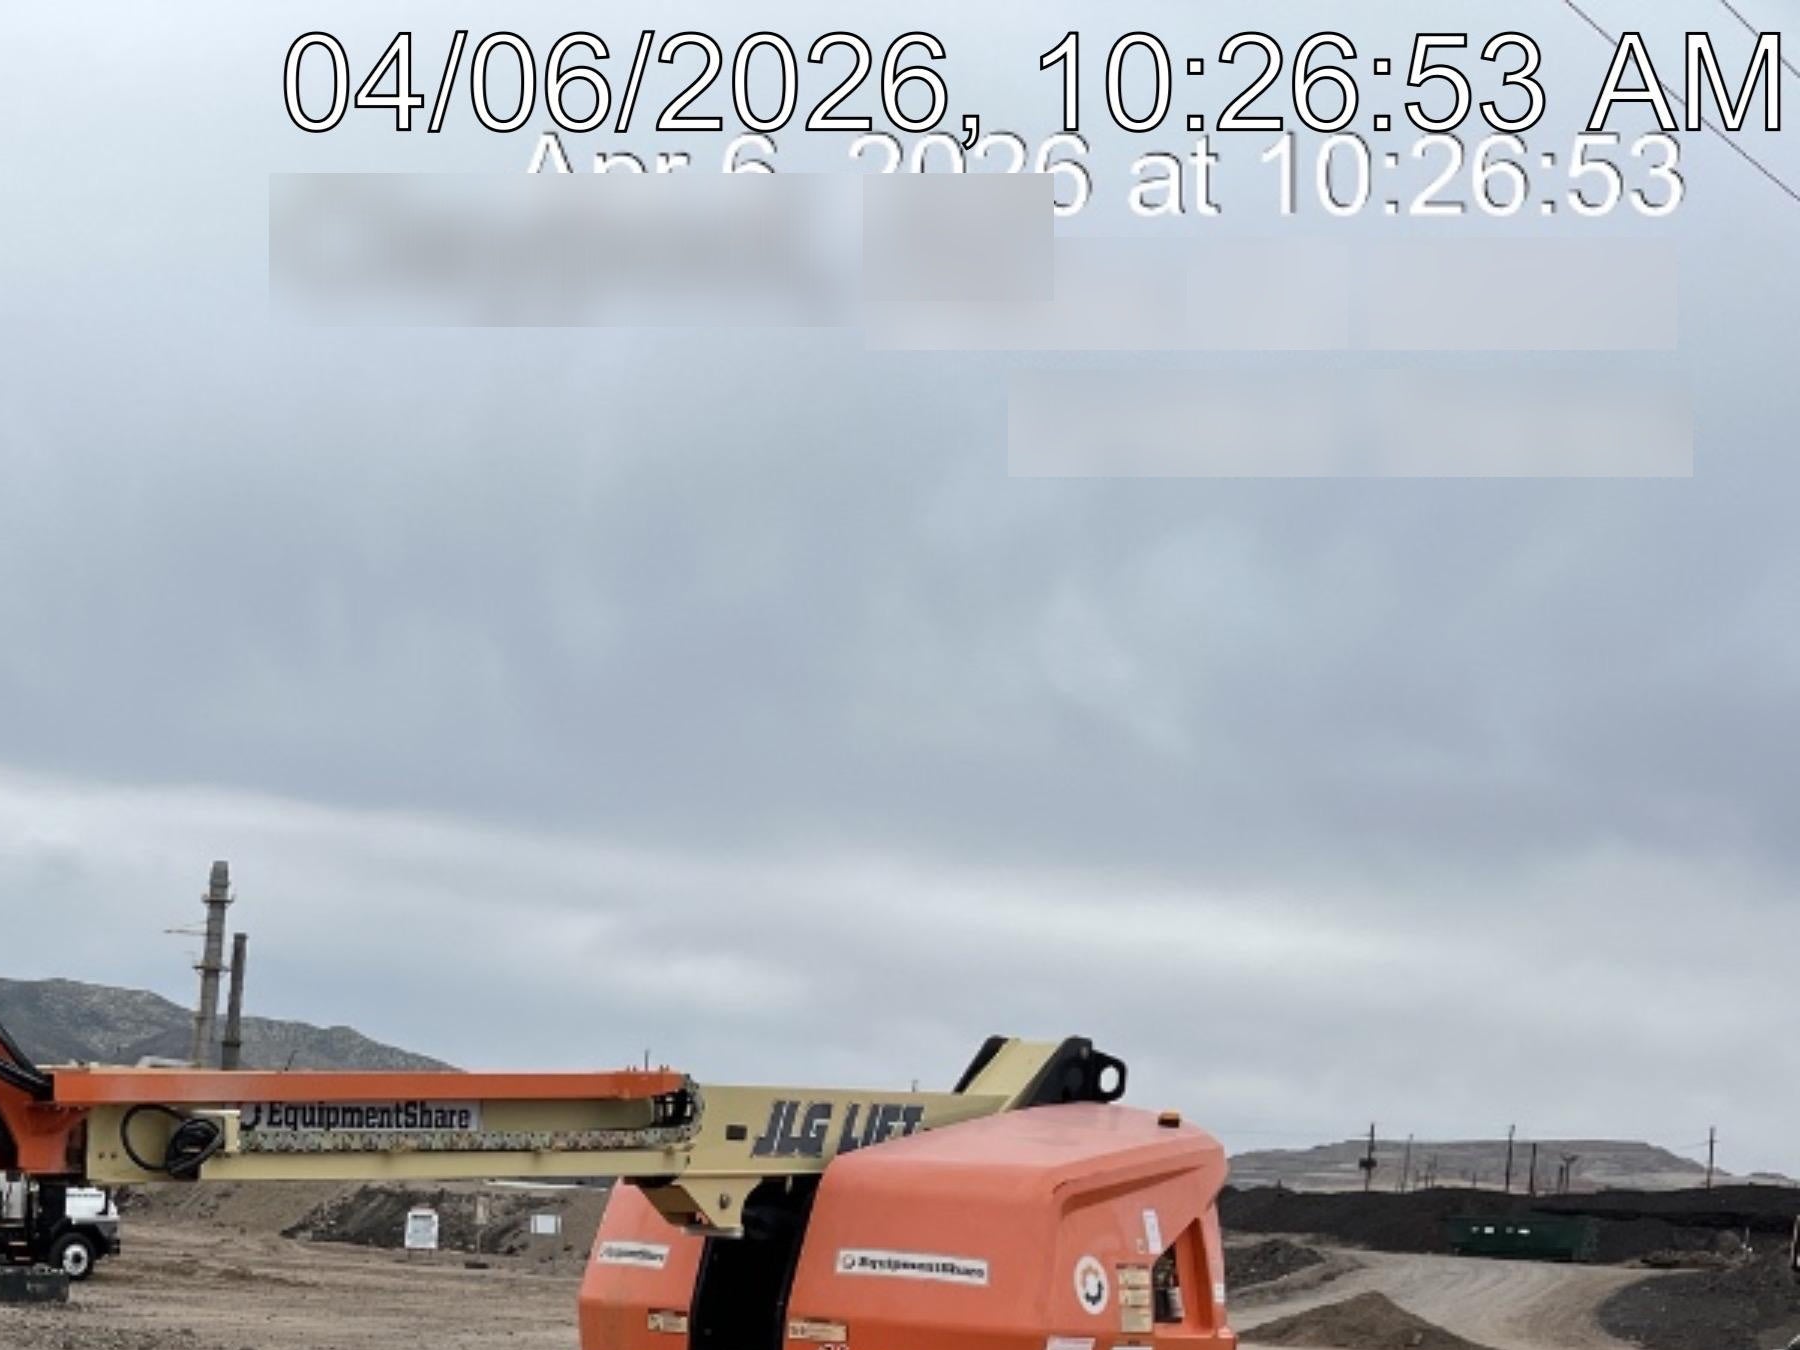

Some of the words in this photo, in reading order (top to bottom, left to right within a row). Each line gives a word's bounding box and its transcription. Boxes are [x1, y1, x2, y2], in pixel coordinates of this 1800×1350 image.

[267, 1101, 472, 1131] EquipmentShare
[750, 1100, 834, 1158] JLG
[835, 1102, 926, 1156] LIFT
